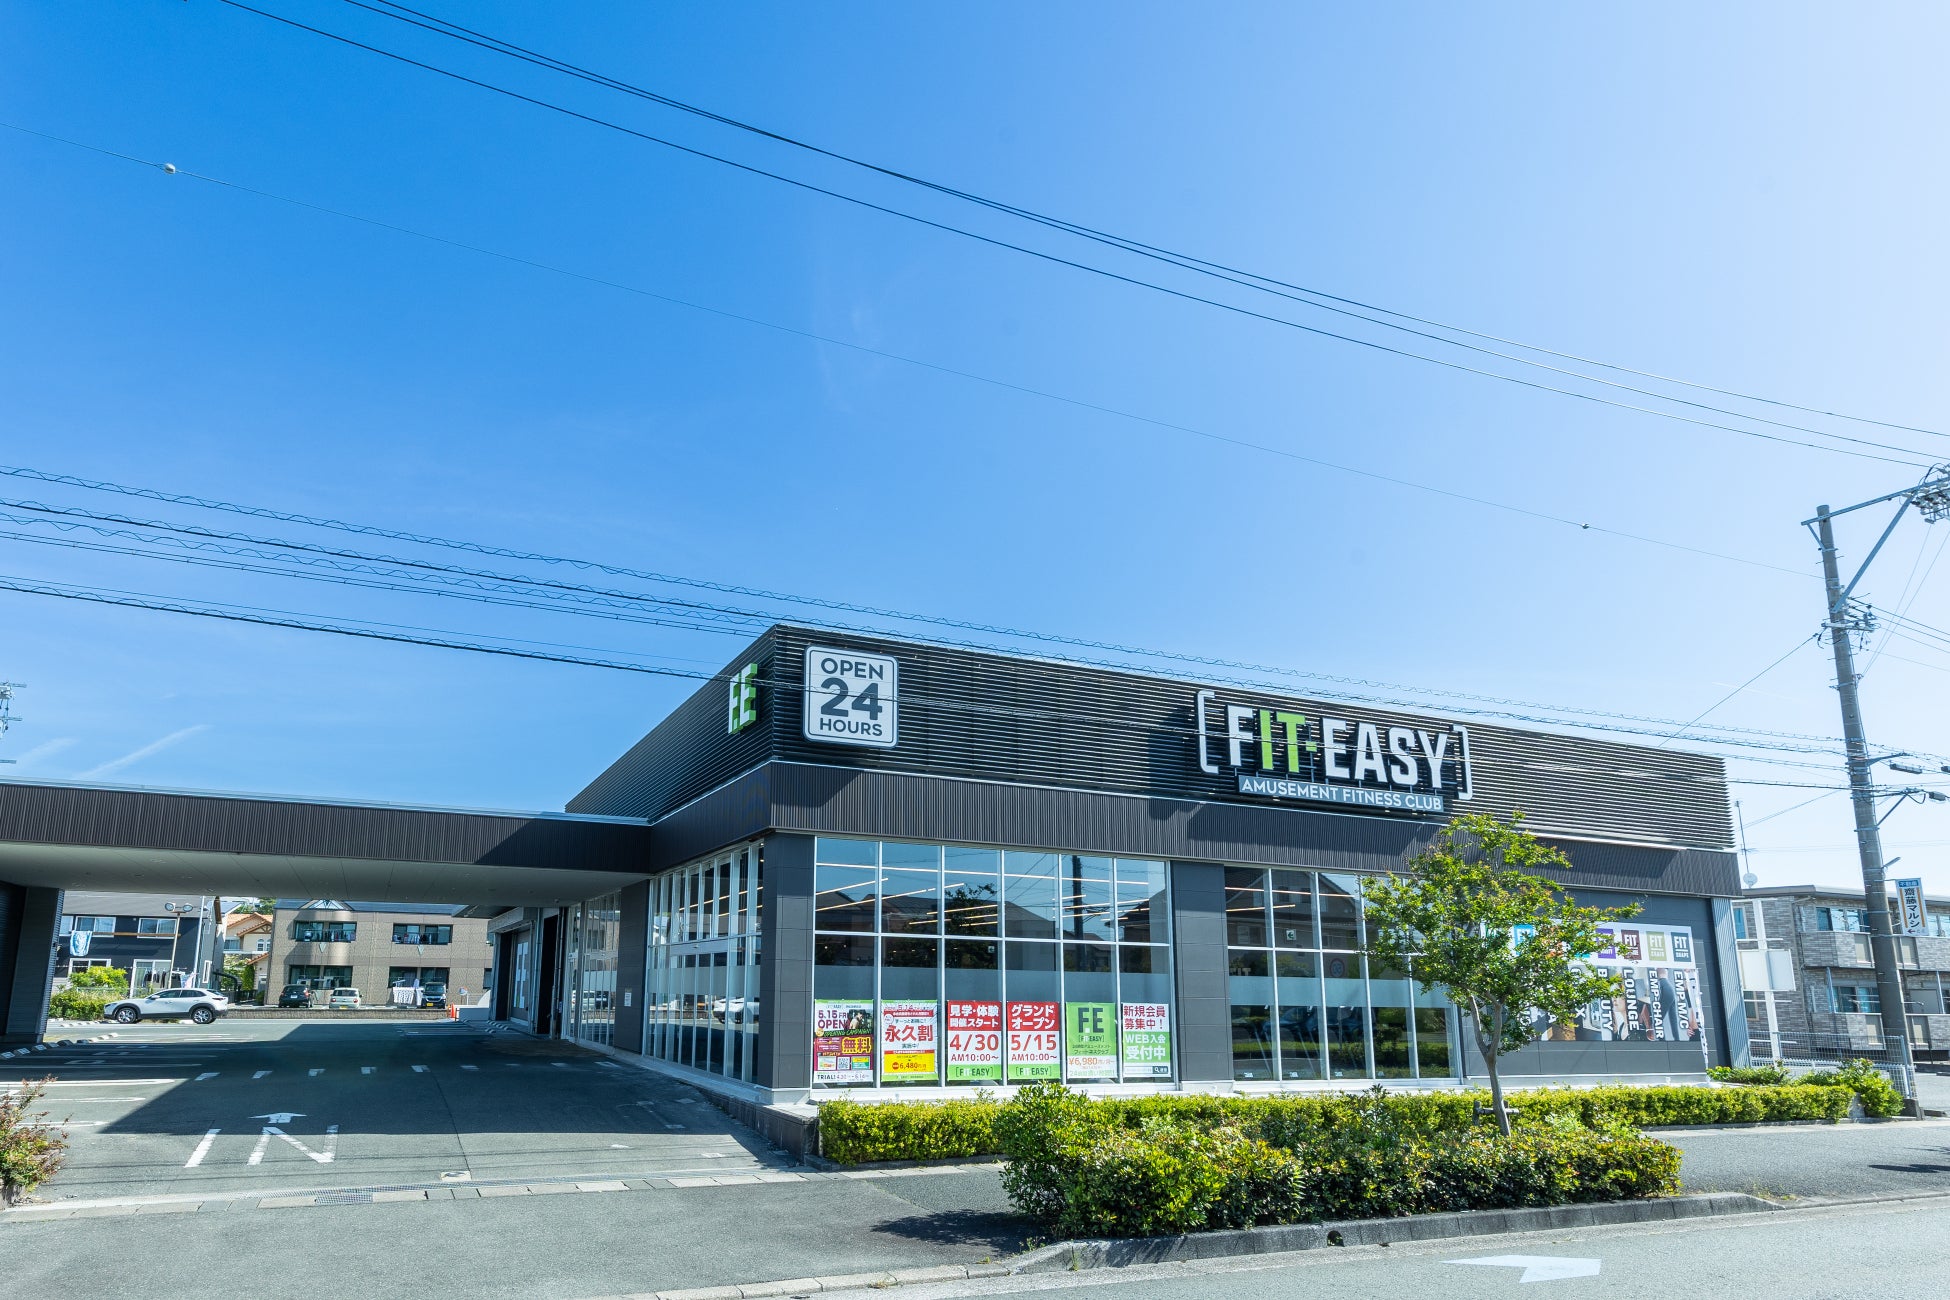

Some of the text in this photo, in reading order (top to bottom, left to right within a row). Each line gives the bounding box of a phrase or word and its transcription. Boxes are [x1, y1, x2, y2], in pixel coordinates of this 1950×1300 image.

[820, 657, 884, 680] OPEN
[820, 677, 883, 721] 24
[819, 718, 883, 737] HOURS
[1242, 778, 1442, 811] AMUSEMENT FITNESS CLUB
[1624, 935, 1637, 946] FIT
[1649, 935, 1662, 947] FIT
[1674, 936, 1687, 948] FIT
[1597, 968, 1613, 1030] BUTY
[1623, 968, 1640, 1031] LOUNGE
[1649, 970, 1664, 1039] EMP-CHAIR
[1011, 1004, 1055, 1017] グランド
[1123, 1005, 1166, 1018] 新規会員
[950, 1018, 999, 1028] 開催スタート
[1011, 1017, 1055, 1029] オープン
[885, 1024, 933, 1042] 永久割
[1125, 1034, 1166, 1044] WEB入会
[842, 1037, 871, 1053] 無料
[949, 1033, 999, 1051] 4/30
[1011, 1034, 1056, 1051] 5/15
[1126, 1045, 1166, 1060] 受付中
[183, 1124, 340, 1168] IN
